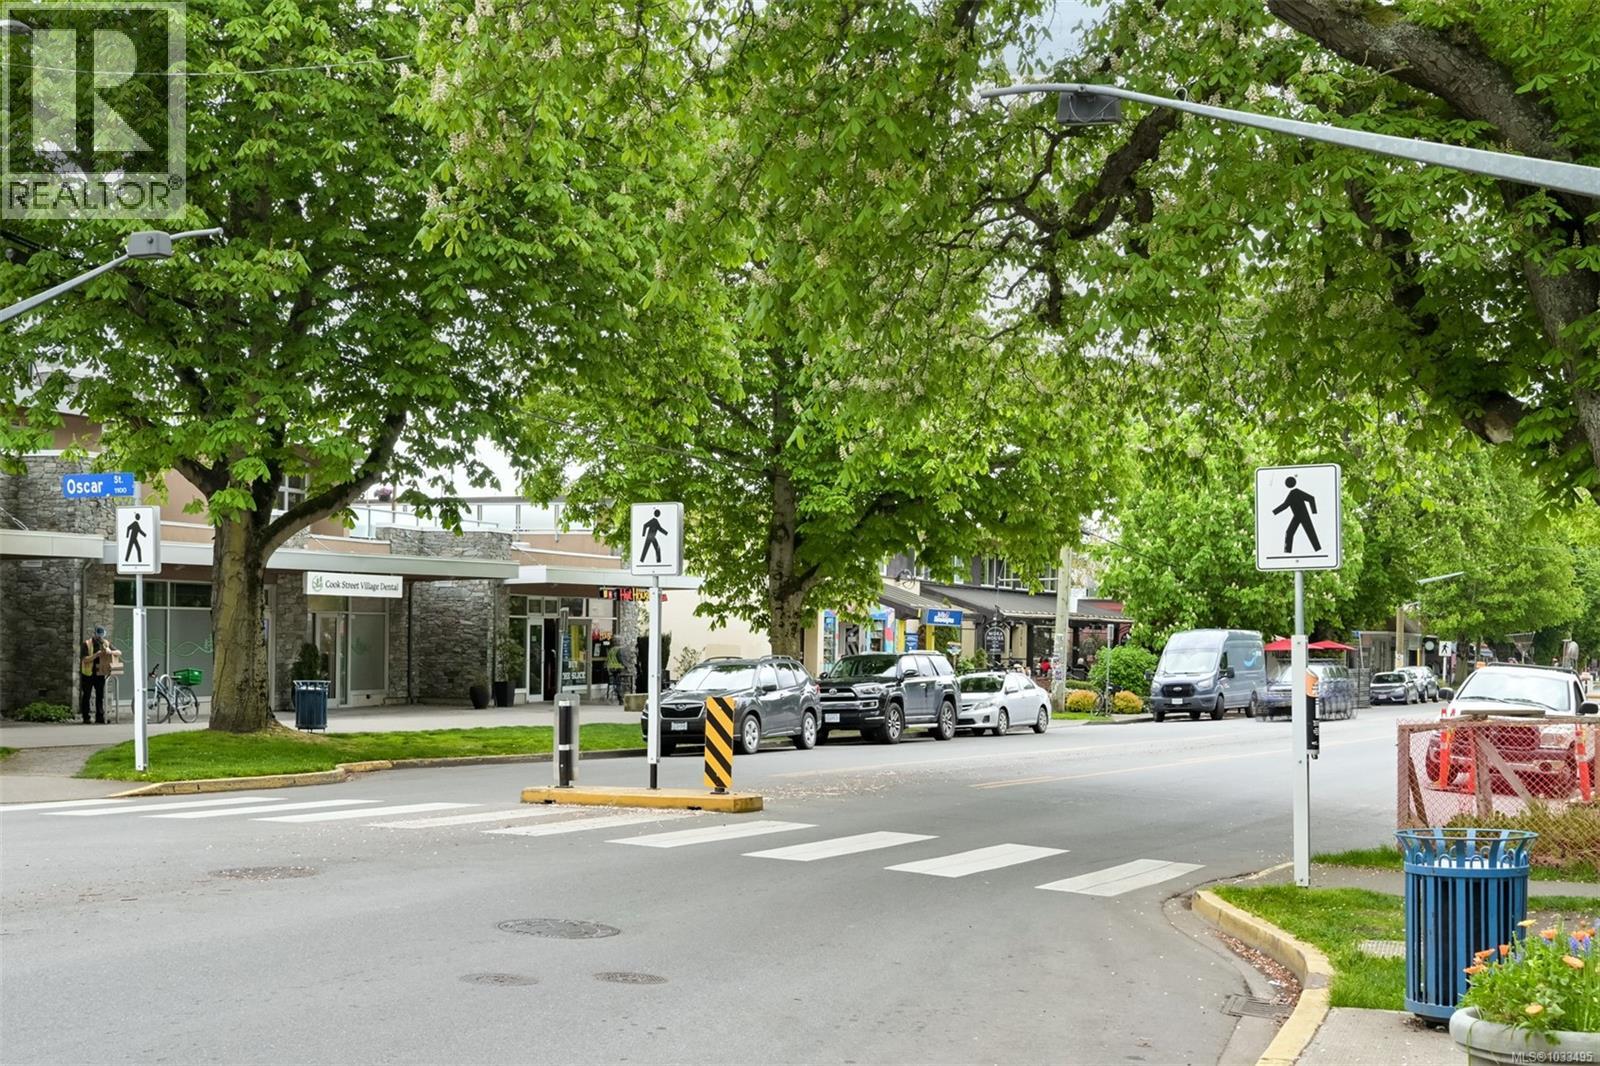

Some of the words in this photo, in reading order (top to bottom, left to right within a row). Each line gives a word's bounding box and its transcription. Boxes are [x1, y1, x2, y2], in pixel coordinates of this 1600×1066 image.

[66, 479, 103, 494] Oscar
[325, 580, 340, 589] Cook
[342, 580, 359, 590] Street
[360, 581, 379, 592] Village
[380, 582, 399, 591] Dental
